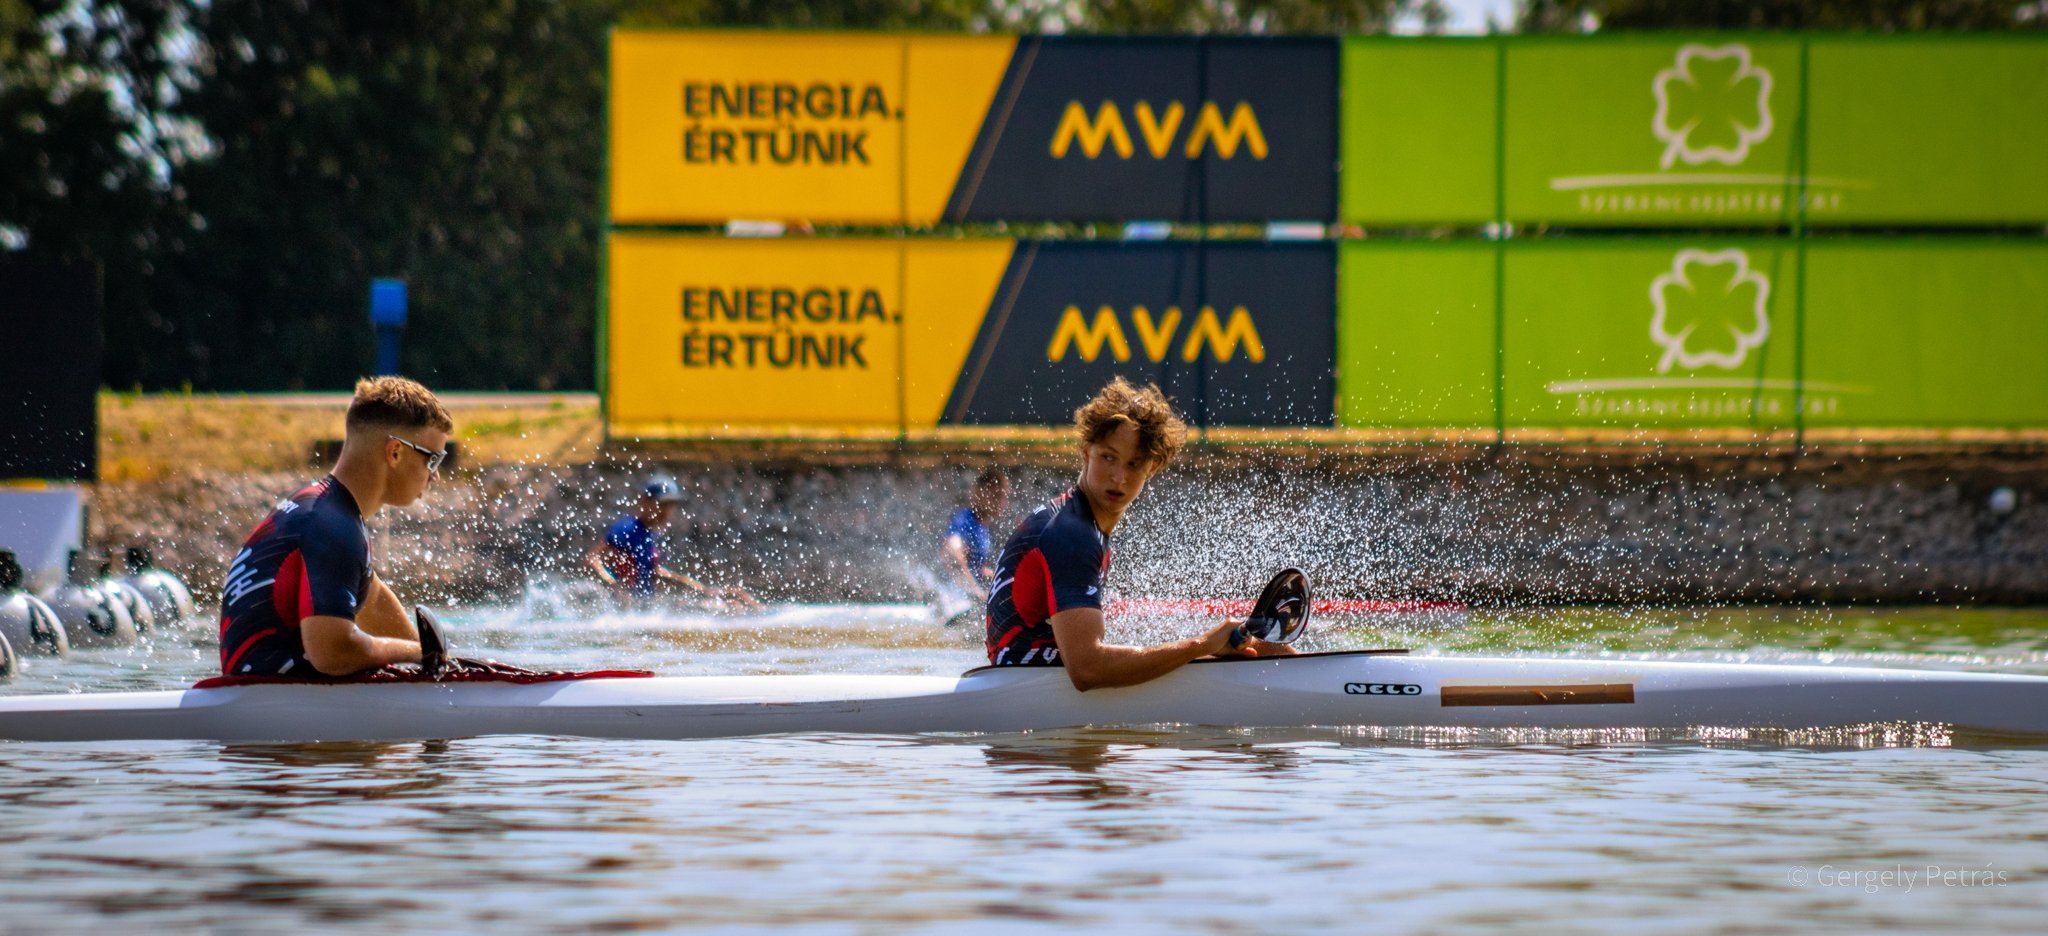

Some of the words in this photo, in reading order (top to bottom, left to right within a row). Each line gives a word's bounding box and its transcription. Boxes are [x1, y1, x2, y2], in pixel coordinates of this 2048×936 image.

[684, 84, 904, 120] ENERGIA.
[684, 123, 870, 164] ÉRTÜNK
[1050, 100, 1269, 160] MVM
[682, 287, 902, 323] ENERGIA.
[682, 326, 868, 368] ÉRTÜNK
[1047, 304, 1265, 363] MVM
[1346, 683, 1421, 695] NELO
